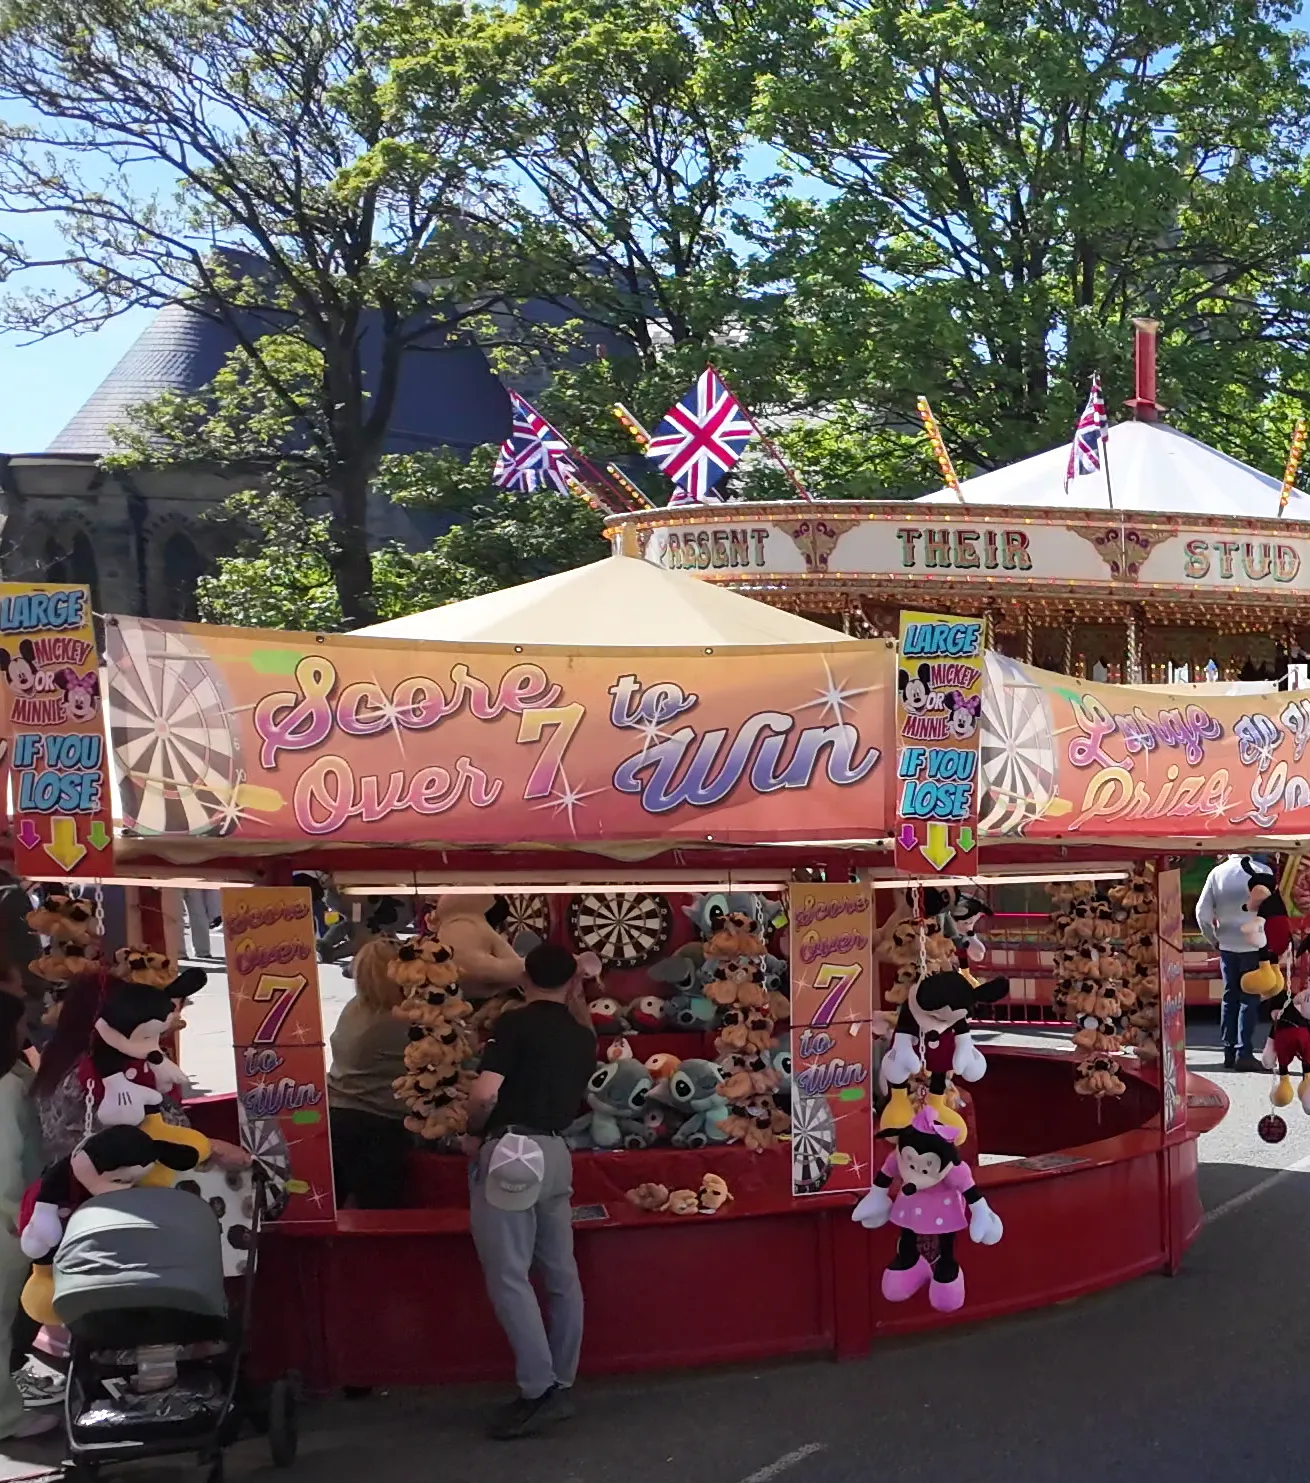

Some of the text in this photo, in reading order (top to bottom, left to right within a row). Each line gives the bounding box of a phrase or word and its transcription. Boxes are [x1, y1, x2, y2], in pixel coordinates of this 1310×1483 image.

[897, 527, 1033, 571] THEIR
[1183, 539, 1300, 583] STUD
[1, 591, 86, 631] LARGE
[34, 638, 93, 666] MICKEY
[904, 624, 981, 657] LARGE
[36, 672, 56, 692] OR
[931, 664, 981, 689] MICKEY
[10, 697, 67, 722] MINNIE
[255, 656, 696, 768] Score to
[926, 692, 945, 711] OR
[902, 716, 949, 740] MINNIE
[1067, 693, 1223, 770] Large
[13, 735, 40, 767] IF
[45, 734, 101, 768] YOU
[292, 702, 880, 835] Over 7 Win
[900, 748, 975, 780] IF YOU
[20, 772, 101, 812] LOSE
[902, 781, 970, 818] LOSE
[1068, 764, 1231, 831] Prize
[228, 900, 309, 935] Score
[796, 894, 869, 931] Score
[237, 939, 311, 973] Over
[801, 930, 867, 962] Over
[253, 973, 307, 1043] 7
[813, 962, 863, 1028] 7
[800, 1029, 835, 1058] to
[244, 1048, 283, 1075] to
[799, 1059, 866, 1094] Win
[243, 1079, 321, 1116] Win
